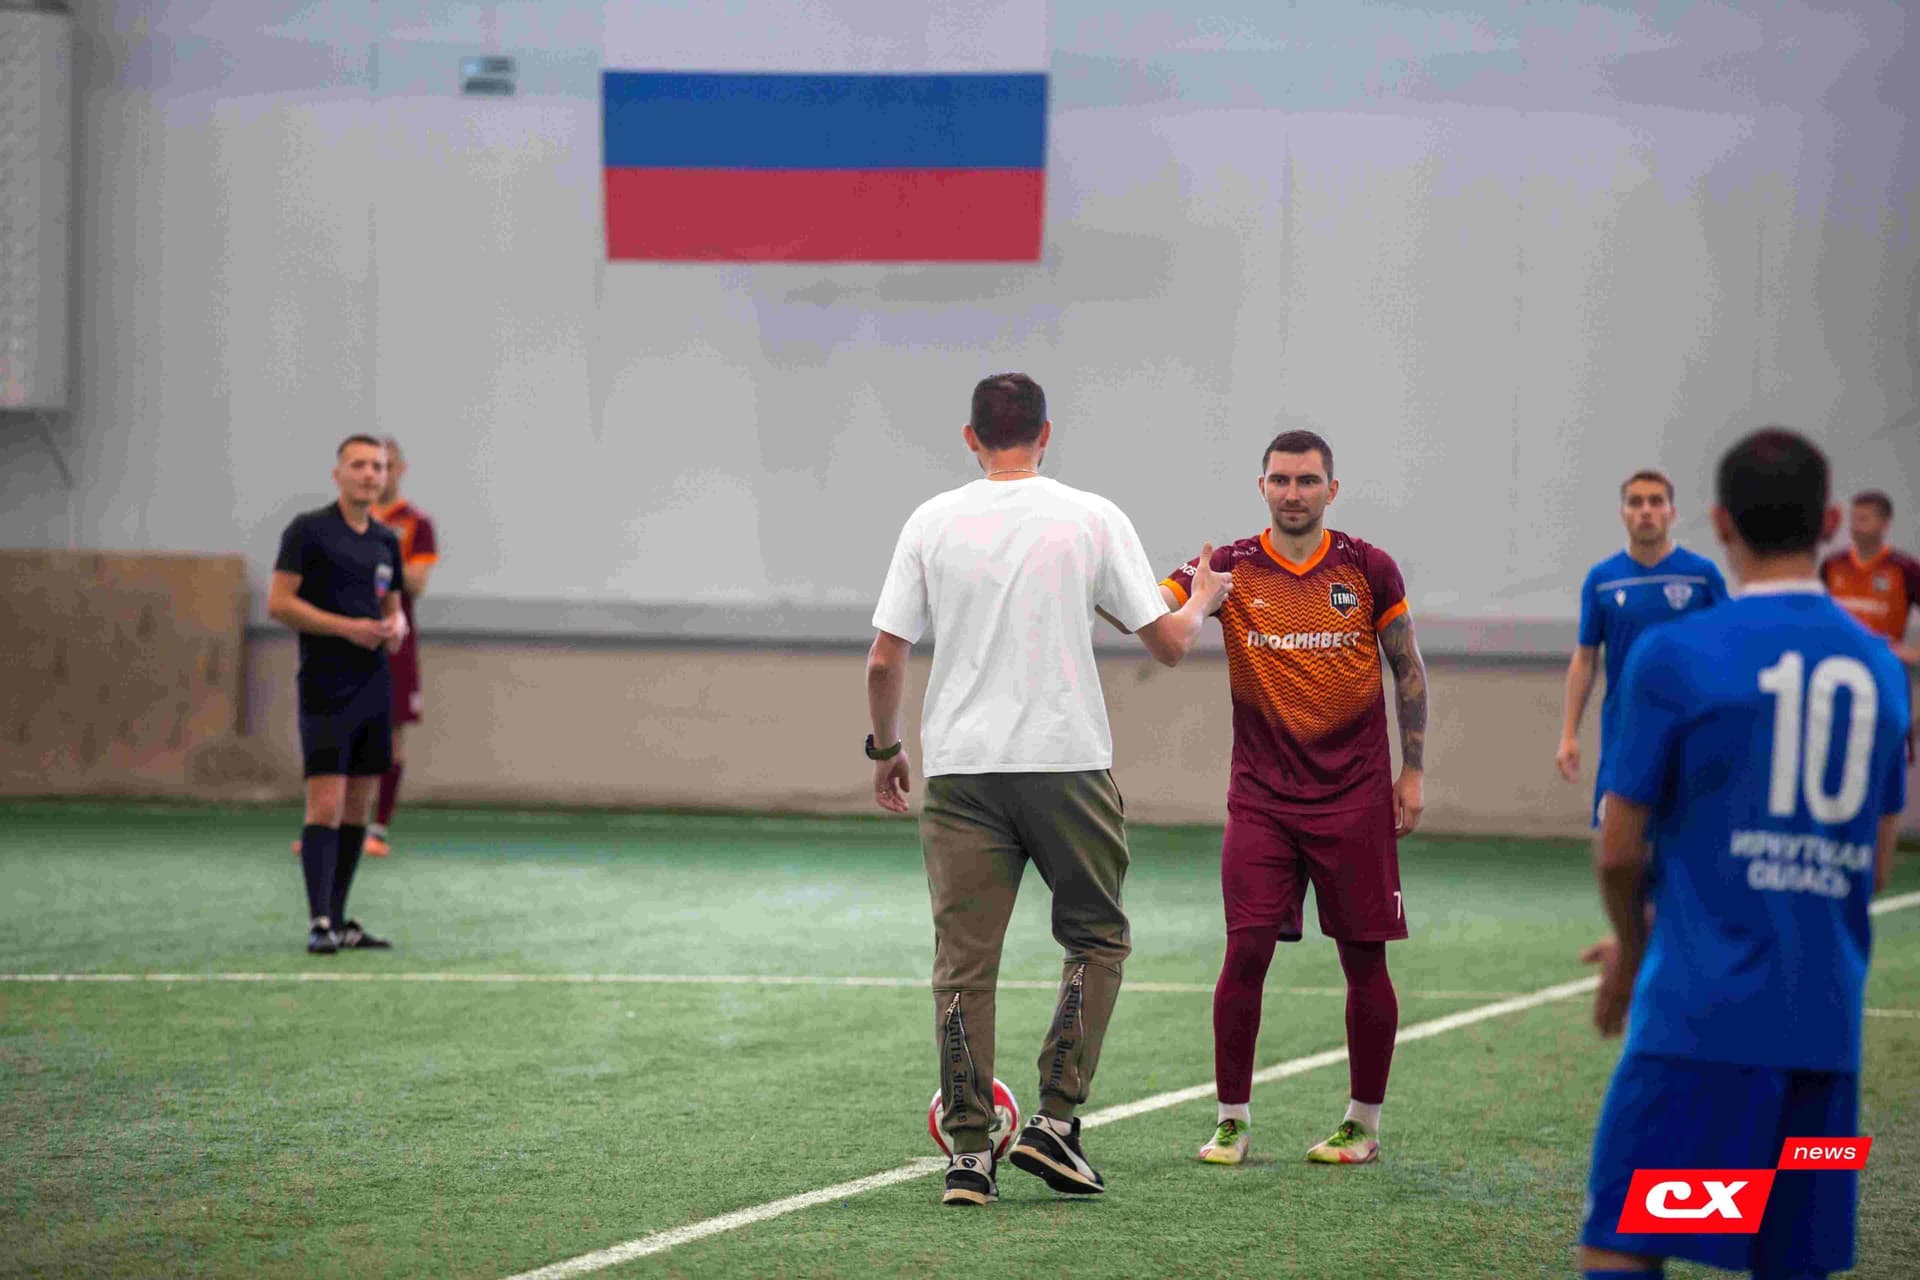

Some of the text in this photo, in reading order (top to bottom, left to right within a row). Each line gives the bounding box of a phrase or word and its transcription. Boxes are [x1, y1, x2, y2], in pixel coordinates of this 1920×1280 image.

[1247, 630, 1361, 650] ПРОДИНВЕСТ
[1757, 649, 1879, 825] 10
[1392, 890, 1402, 921] 7
